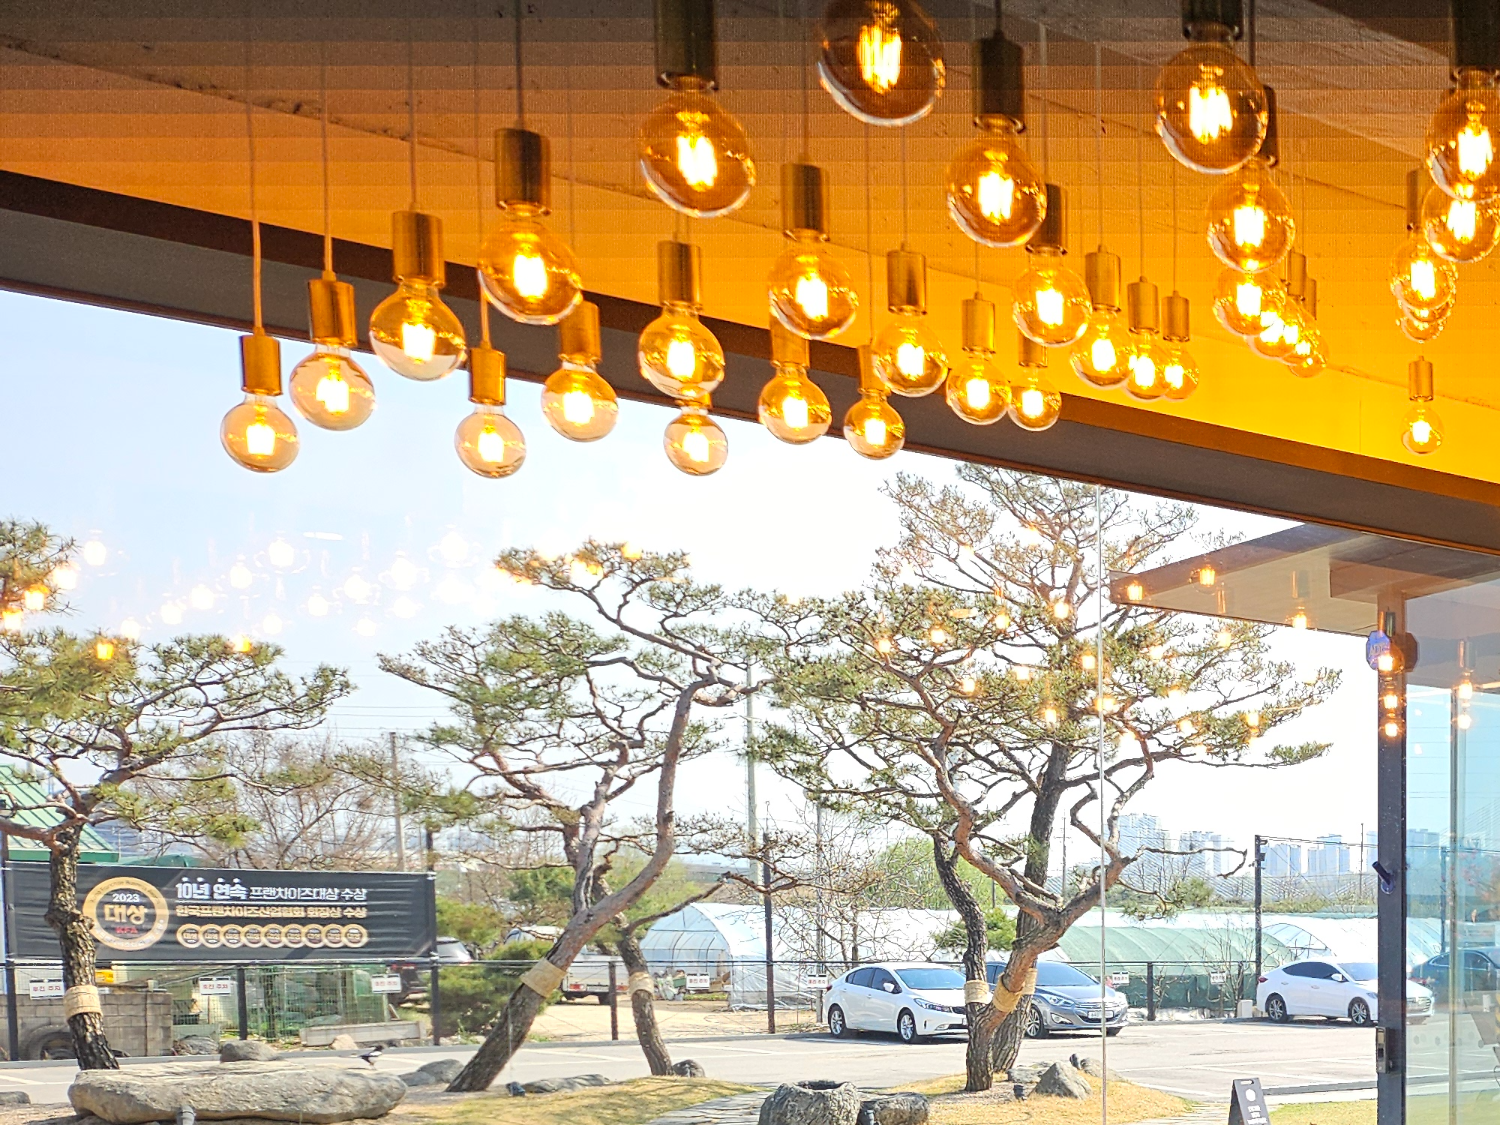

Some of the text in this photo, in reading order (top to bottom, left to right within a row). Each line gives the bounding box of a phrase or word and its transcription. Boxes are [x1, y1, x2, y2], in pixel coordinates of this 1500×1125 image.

[112, 892, 140, 903] 2023
[176, 881, 367, 901] 10년 연속 프랜차이즈대상 수상
[104, 903, 148, 925] 대상
[343, 905, 368, 919] 수상
[115, 926, 138, 935] KFA
